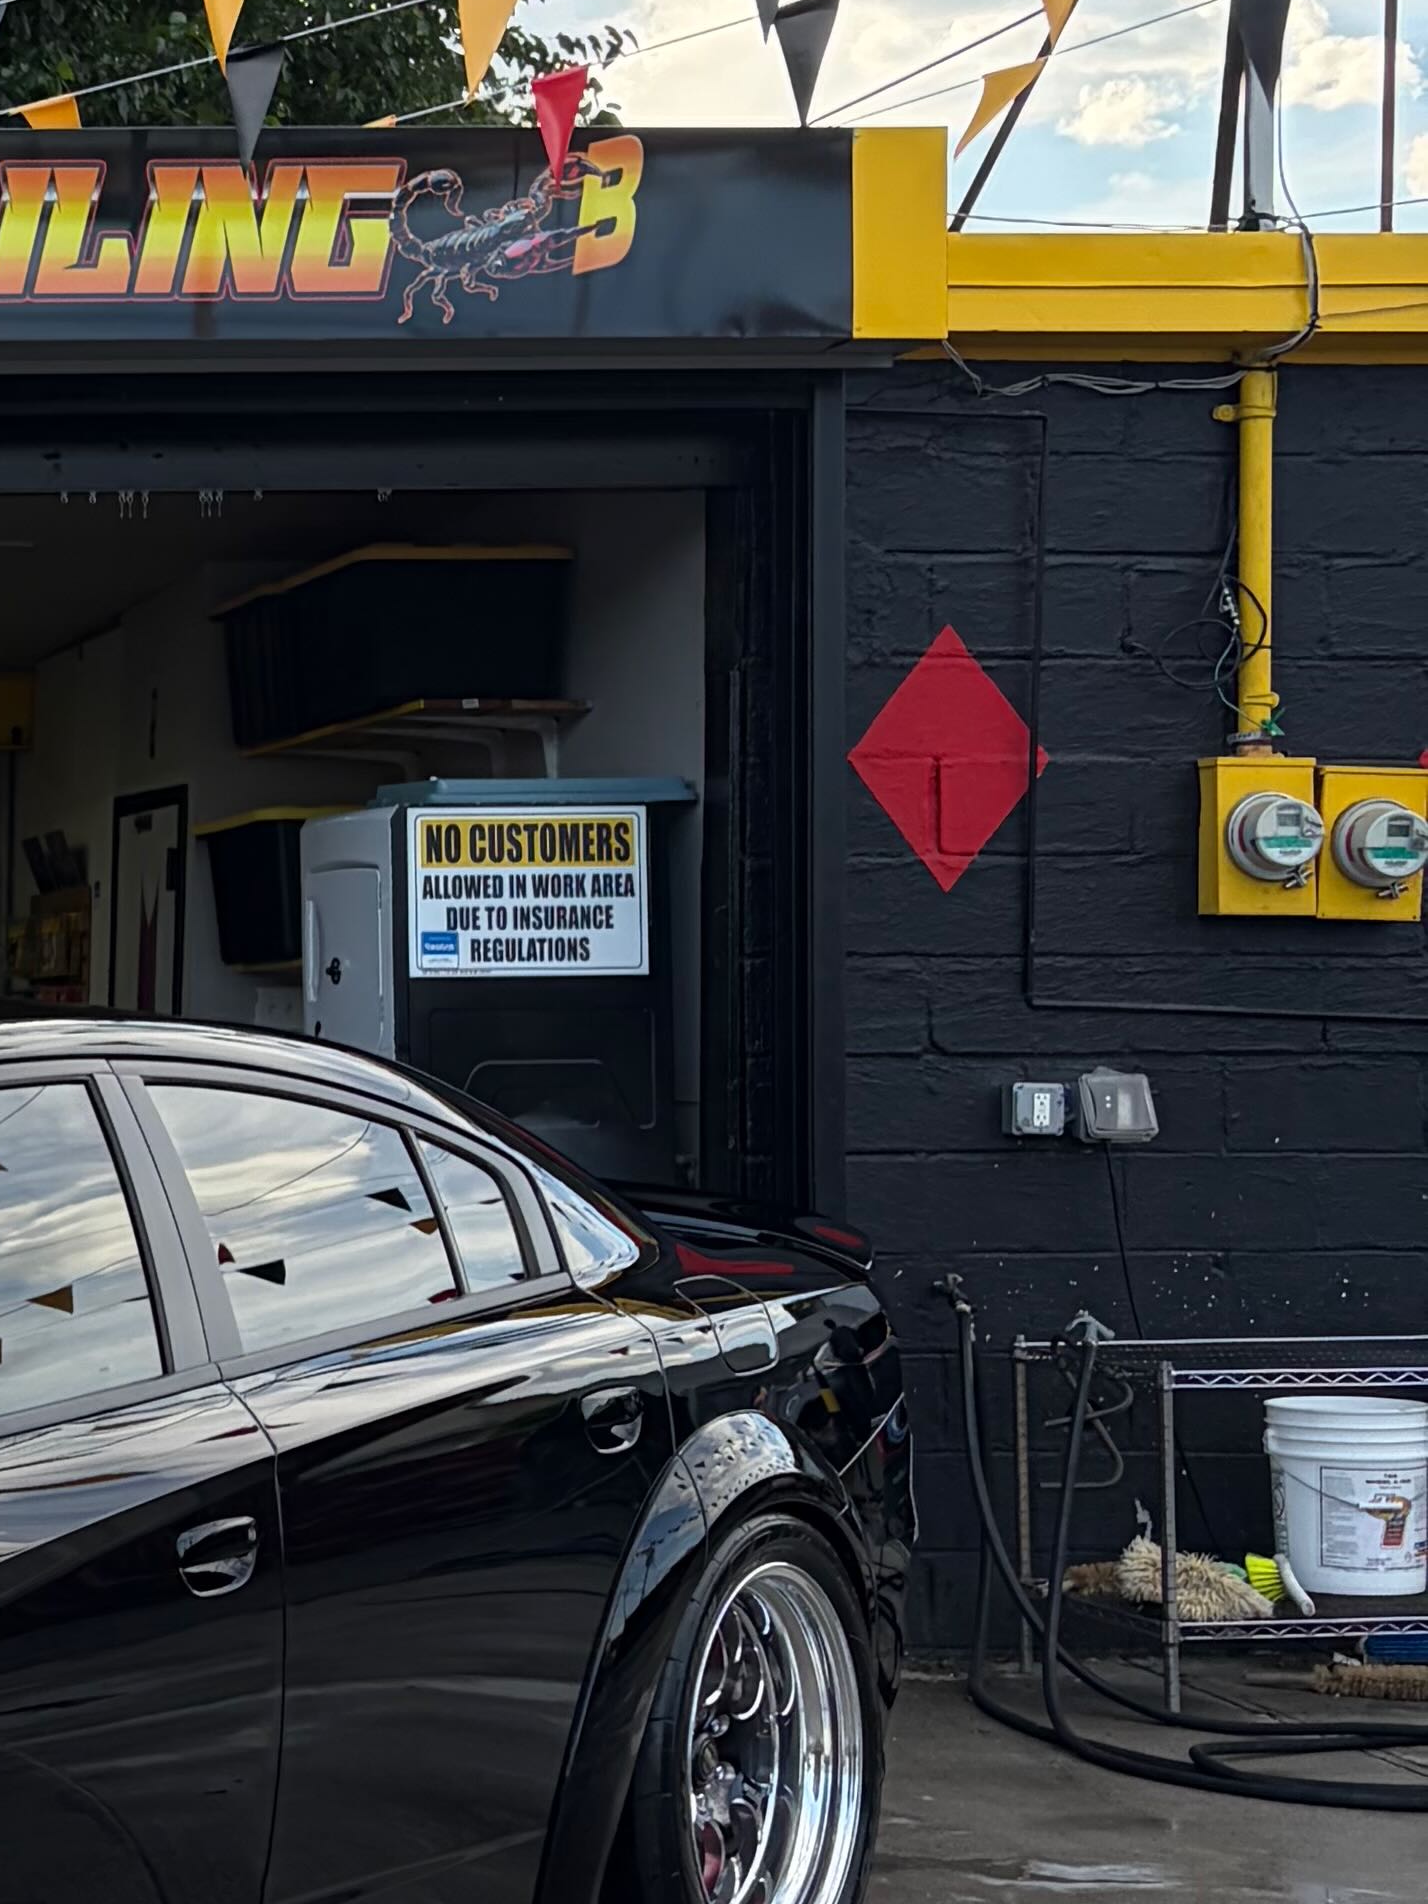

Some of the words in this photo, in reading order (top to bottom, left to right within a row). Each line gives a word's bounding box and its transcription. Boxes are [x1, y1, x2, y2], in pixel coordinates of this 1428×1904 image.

[425, 823, 461, 864] NO
[469, 822, 630, 864] CUSTOMERS
[422, 874, 504, 900] ALLOWED
[509, 874, 527, 899] IN
[531, 873, 586, 899] WORK
[590, 873, 635, 898] AREA
[446, 906, 481, 931] DUE
[484, 905, 507, 930] TO
[513, 905, 614, 930] INSURANCE
[470, 936, 590, 963] REGULATIONS
